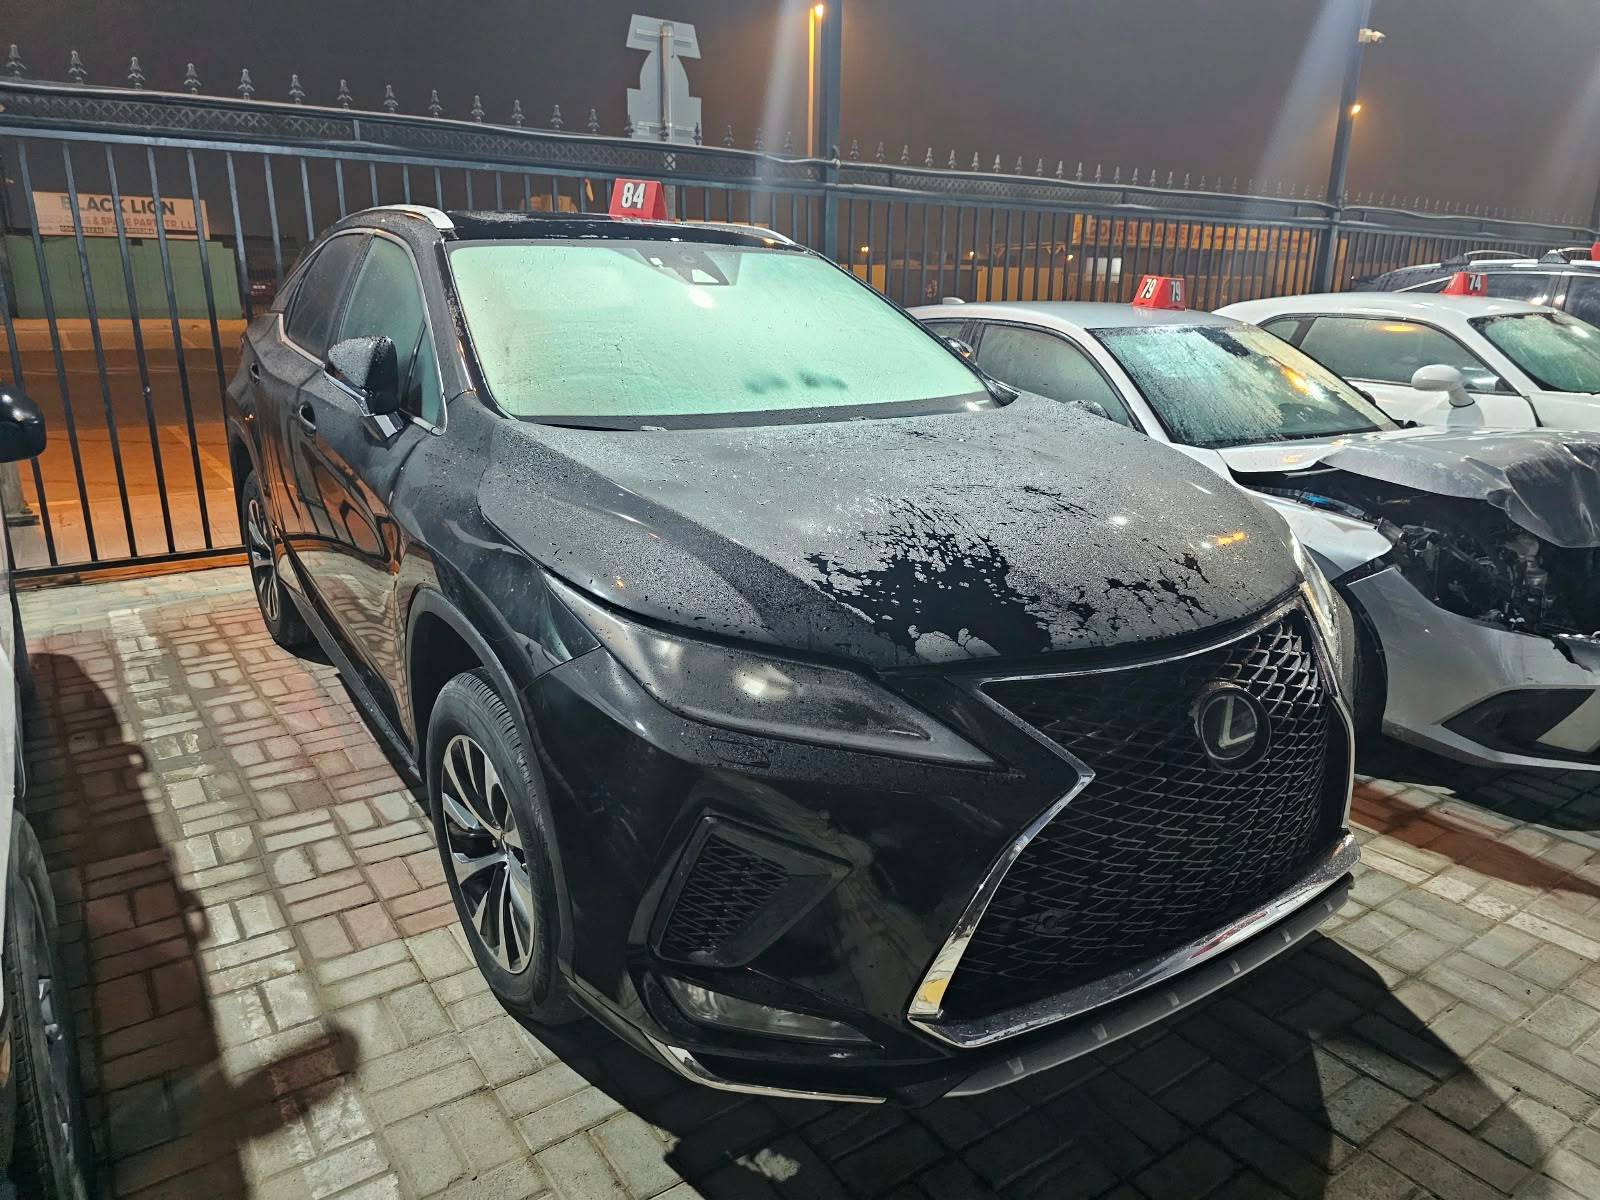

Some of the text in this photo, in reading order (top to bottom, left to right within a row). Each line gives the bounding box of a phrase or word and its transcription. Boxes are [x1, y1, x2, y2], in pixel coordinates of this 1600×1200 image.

[621, 182, 646, 209] 84
[131, 199, 176, 215] LION
[101, 216, 133, 227] SPE
[1140, 278, 1158, 299] 79
[1170, 280, 1181, 302] 79
[1469, 273, 1482, 291] 74
